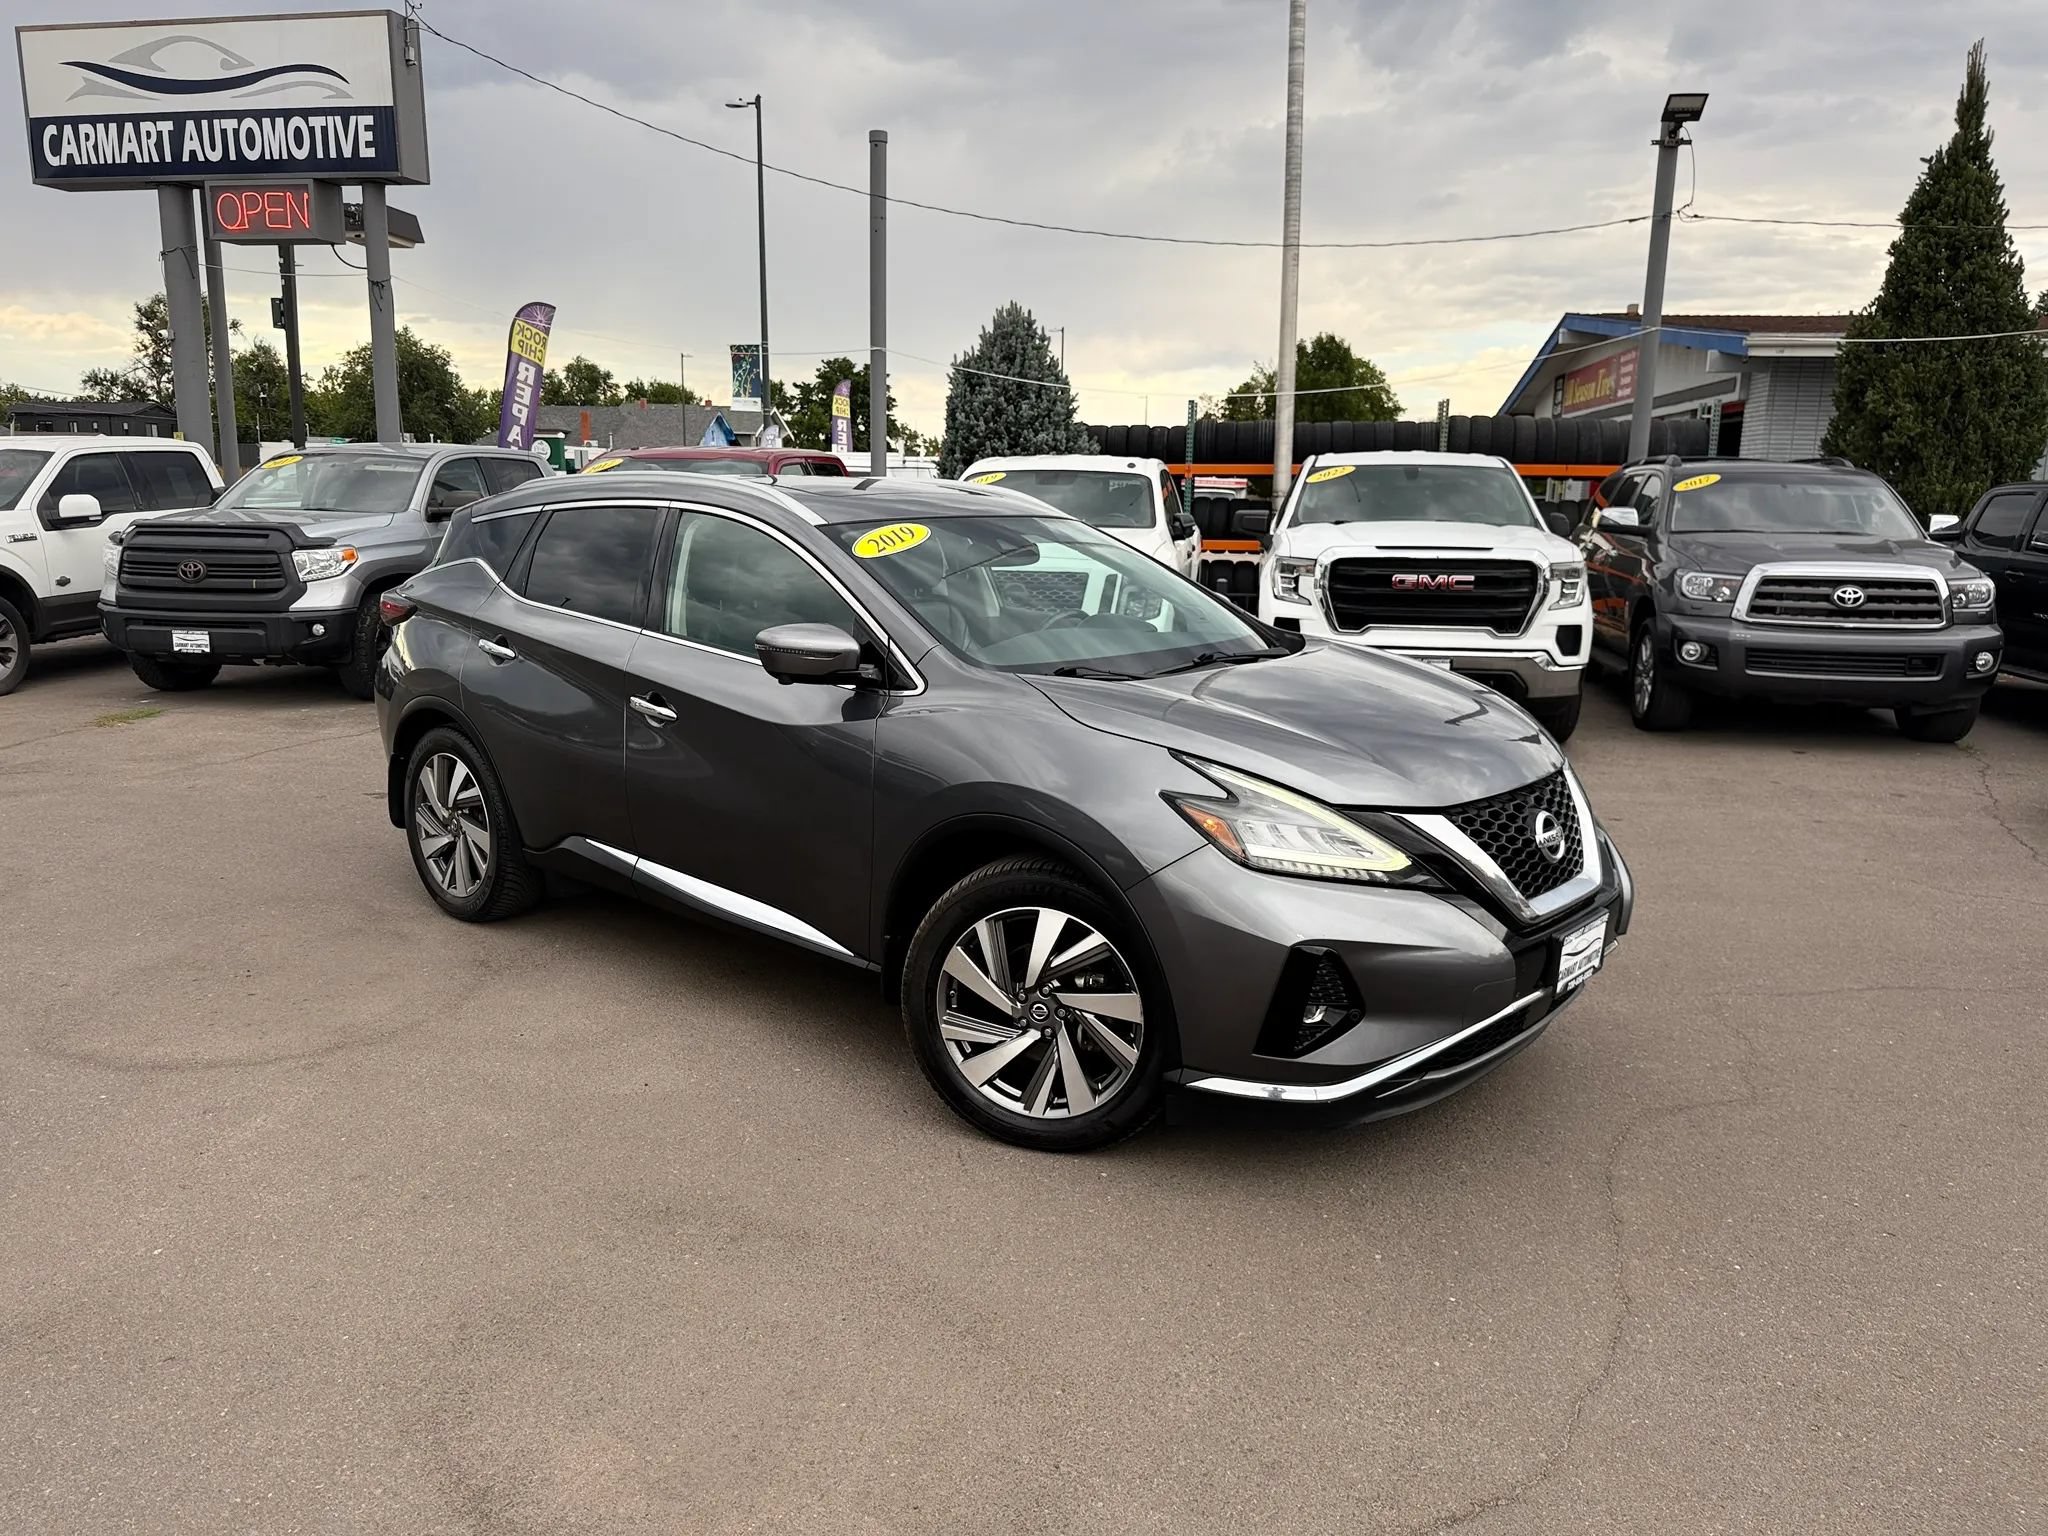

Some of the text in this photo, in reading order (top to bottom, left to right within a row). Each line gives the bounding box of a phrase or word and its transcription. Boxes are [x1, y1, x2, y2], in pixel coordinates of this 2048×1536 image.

[42, 115, 376, 167] CARMART AUTOMOTIVE
[216, 192, 310, 230] OPEN
[867, 526, 915, 553] 2019
[1392, 574, 1475, 591] GMC
